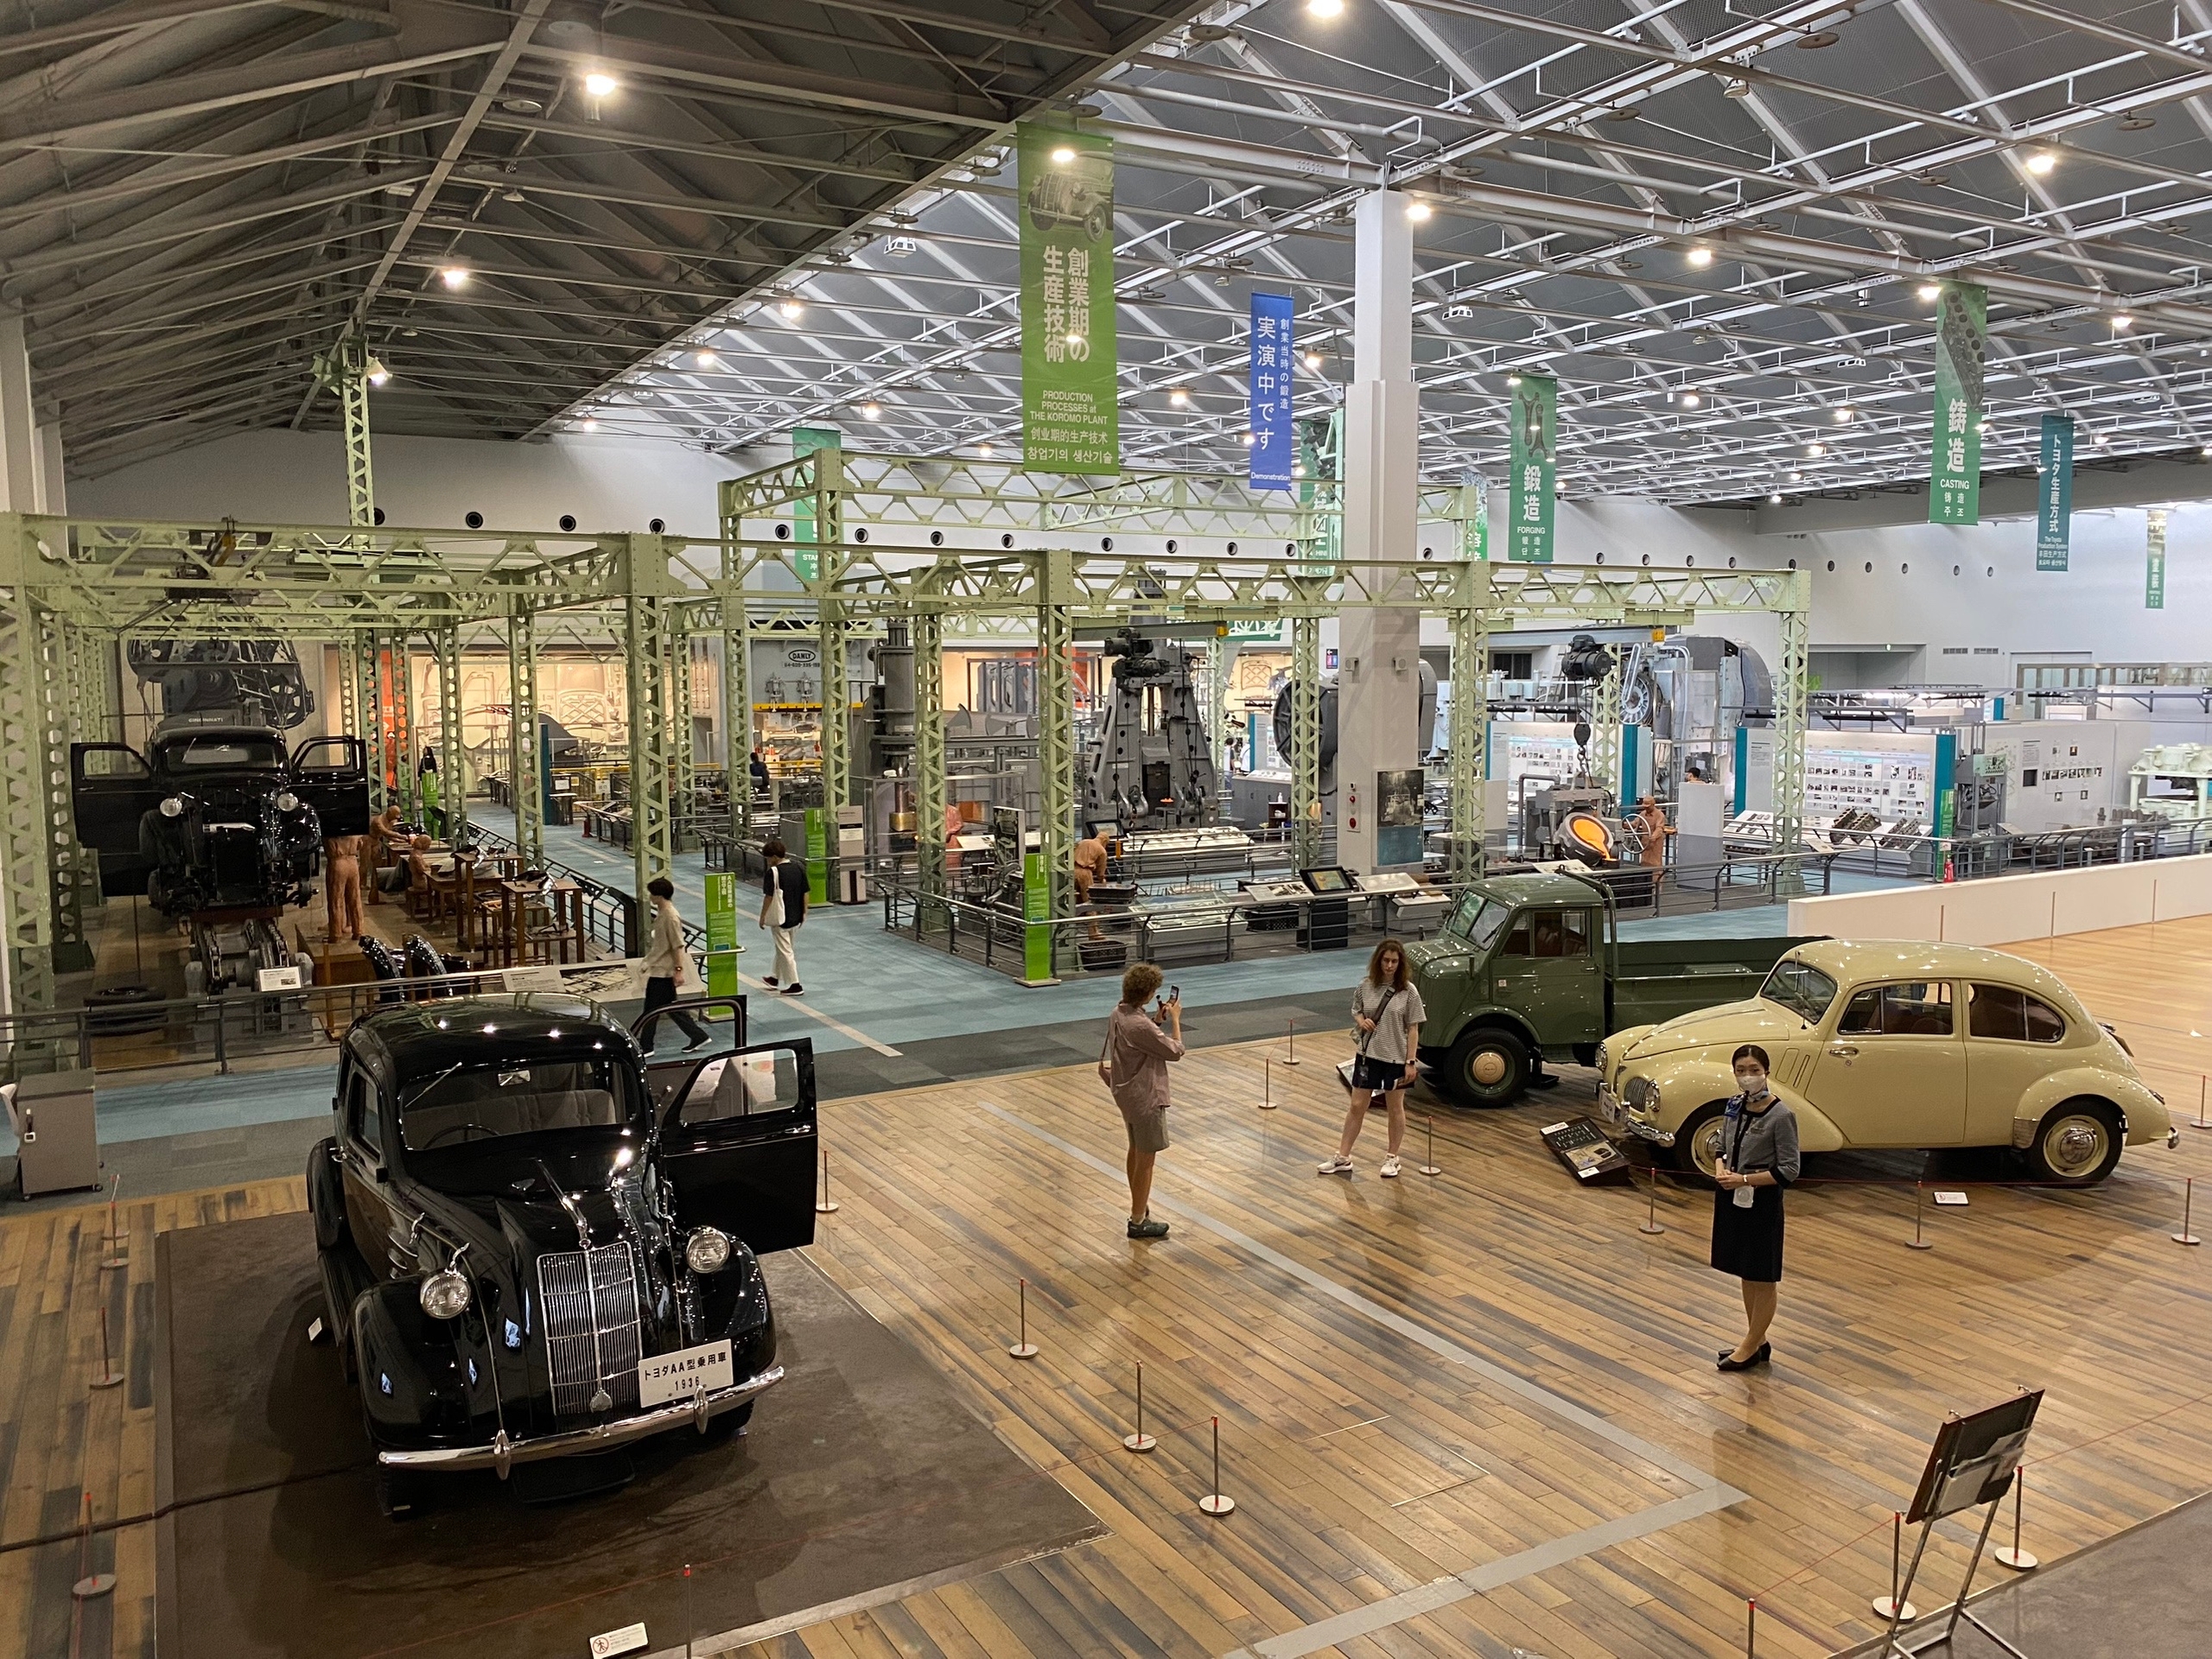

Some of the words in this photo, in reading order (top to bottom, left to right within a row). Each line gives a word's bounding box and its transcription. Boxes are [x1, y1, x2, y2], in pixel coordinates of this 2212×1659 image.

[1043, 245, 1065, 363] 生産技術
[1067, 246, 1090, 362] 創業期の
[1280, 318, 1290, 410] 創業当時の鍛造
[1257, 315, 1276, 450] 実演中です
[1042, 390, 1094, 403] PRODUCTION
[1041, 401, 1089, 414] PROCESSES
[1030, 410, 1046, 421] THE
[1046, 412, 1082, 423] KOROMO
[1083, 415, 1109, 425] PLANT
[1031, 427, 1109, 445] 创业期的生产技术
[1947, 397, 1967, 473] 鋳造
[1027, 446, 1069, 462] 창업기의
[1072, 449, 1114, 465] 생산기술
[1250, 471, 1291, 481] Demonstration
[1940, 478, 1970, 490] CASTING
[2049, 434, 2062, 533] トヨタ生産方式
[1523, 464, 1541, 522] 鍛造
[1516, 526, 1546, 535] FORGING
[645, 1351, 727, 1381] トヨダAA型乗用車
[675, 1376, 700, 1391] 1936
